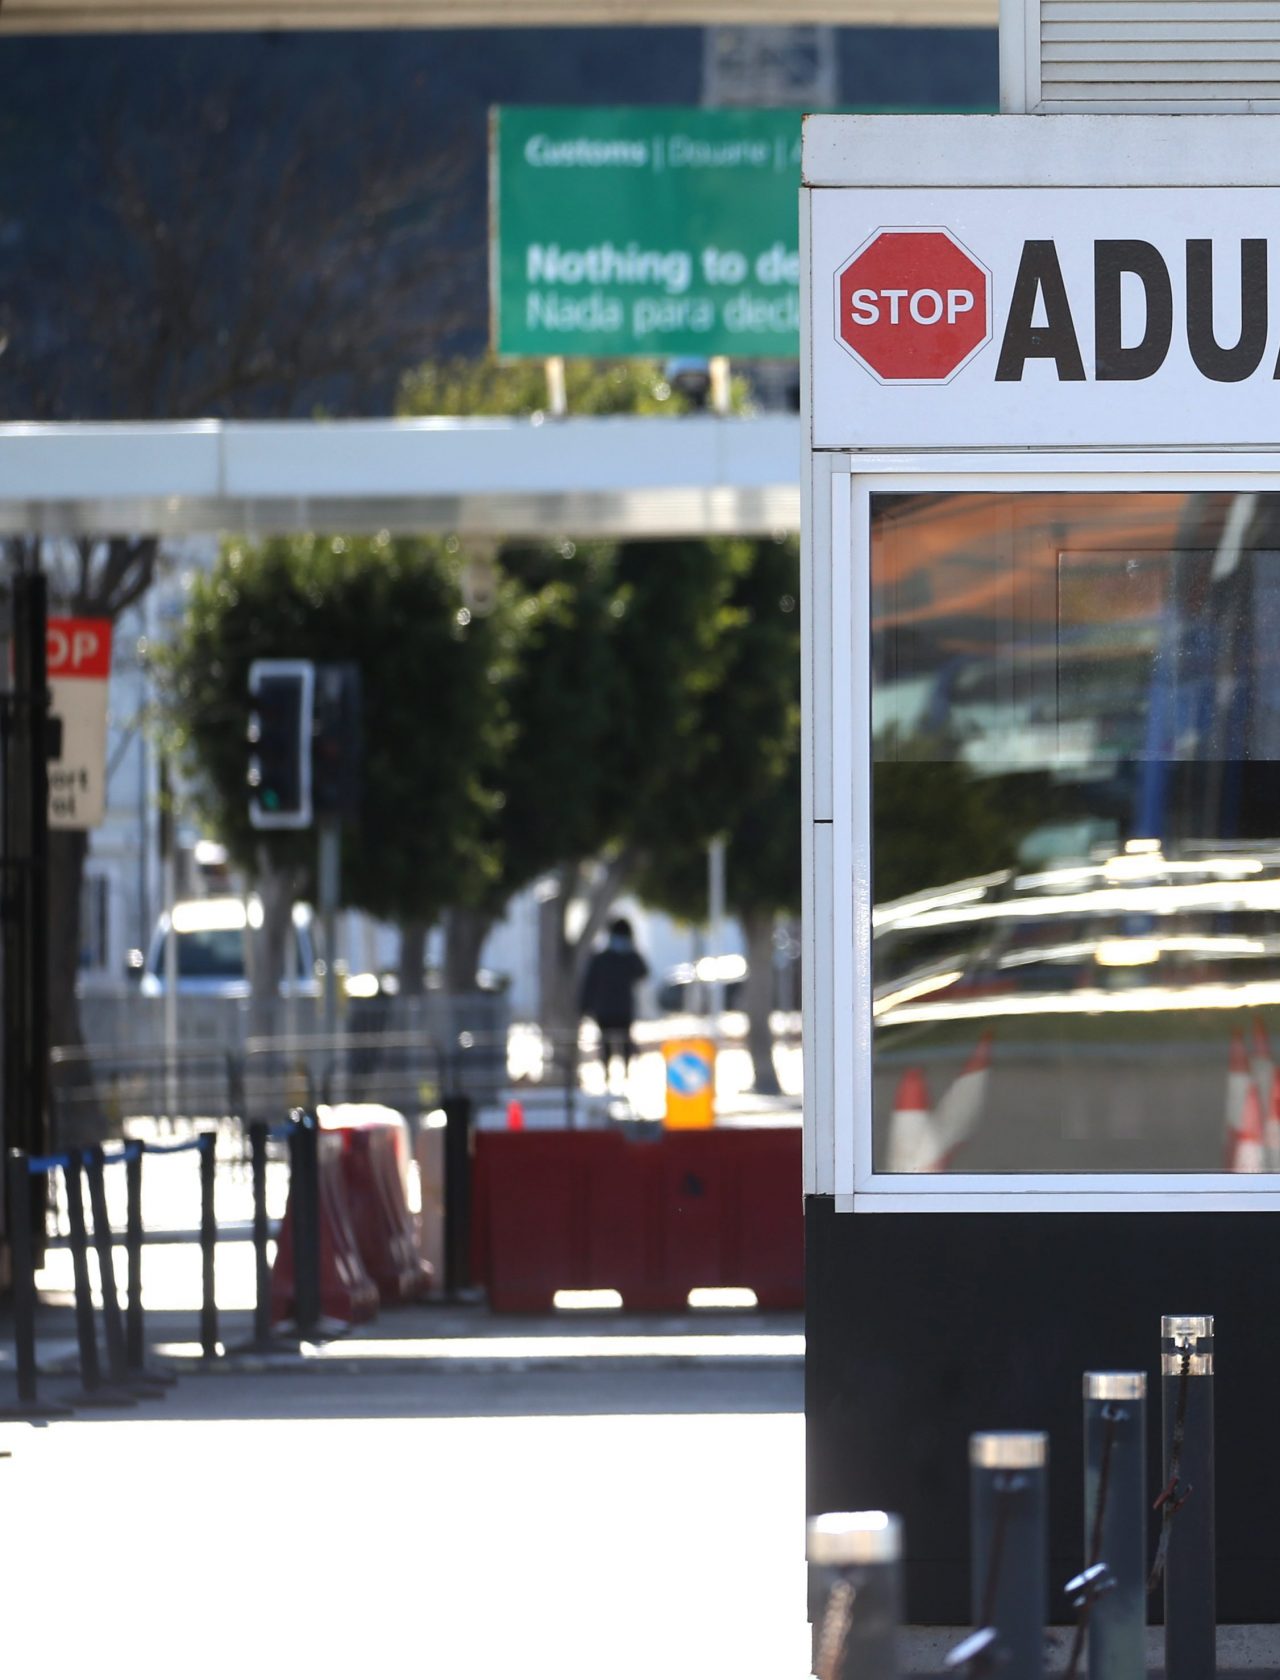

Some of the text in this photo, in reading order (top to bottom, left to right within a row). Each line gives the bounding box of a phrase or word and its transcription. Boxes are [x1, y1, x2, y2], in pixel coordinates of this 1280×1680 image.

[526, 135, 646, 166] Customs
[669, 136, 765, 166] Douane
[526, 243, 692, 293] Nothing
[702, 247, 747, 284] to
[526, 291, 622, 332] Nada
[633, 299, 714, 339] para
[851, 288, 975, 326] STOP
